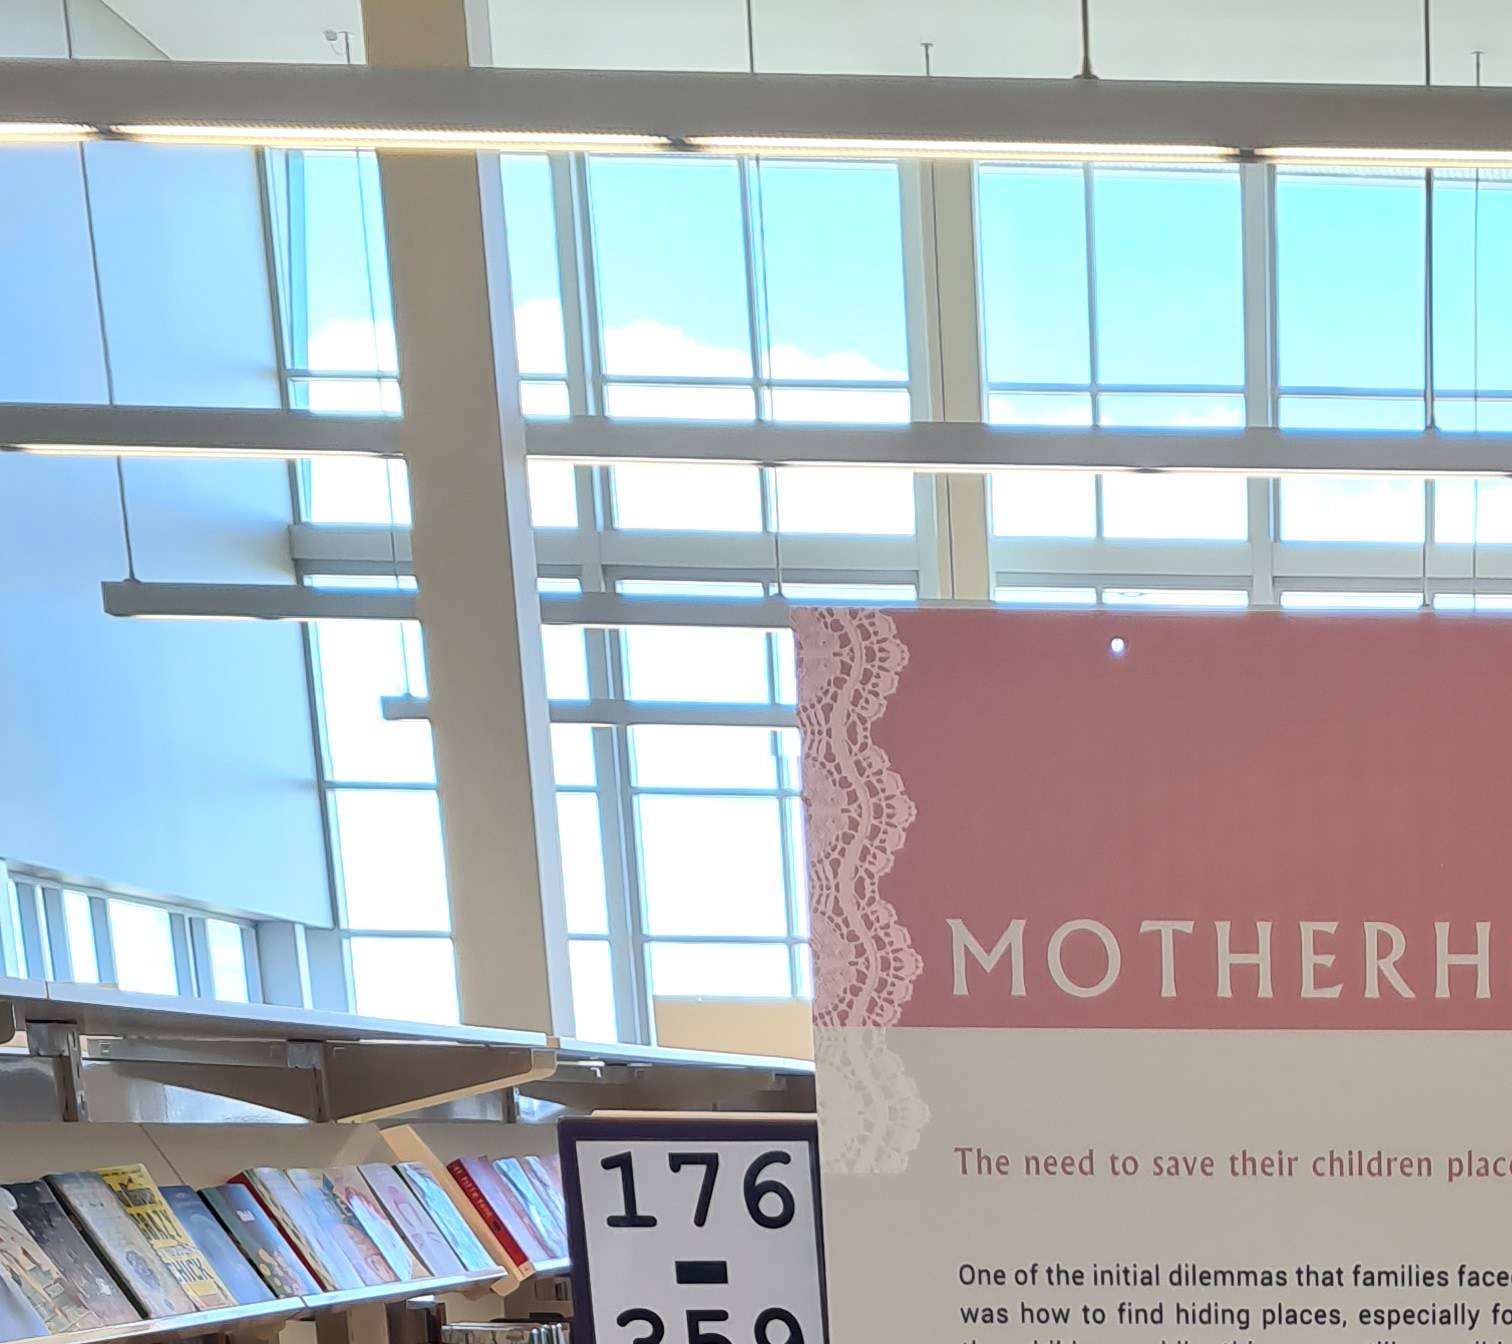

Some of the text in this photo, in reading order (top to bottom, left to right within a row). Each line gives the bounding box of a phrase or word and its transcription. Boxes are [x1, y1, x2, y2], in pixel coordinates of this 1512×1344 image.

[953, 1146, 1010, 1176] The
[1024, 1148, 1095, 1177] need
[1109, 1153, 1139, 1177] to
[1152, 1155, 1215, 1177] save
[1229, 1149, 1299, 1177] their
[1312, 1149, 1432, 1178] children
[601, 1151, 795, 1229] 176
[959, 1263, 1007, 1286] One
[1014, 1262, 1039, 1286] of
[1045, 1263, 1085, 1287] the
[1093, 1263, 1160, 1287] initial
[1168, 1263, 1288, 1287] dilemmas
[1295, 1263, 1345, 1288] that
[1352, 1263, 1449, 1288] families
